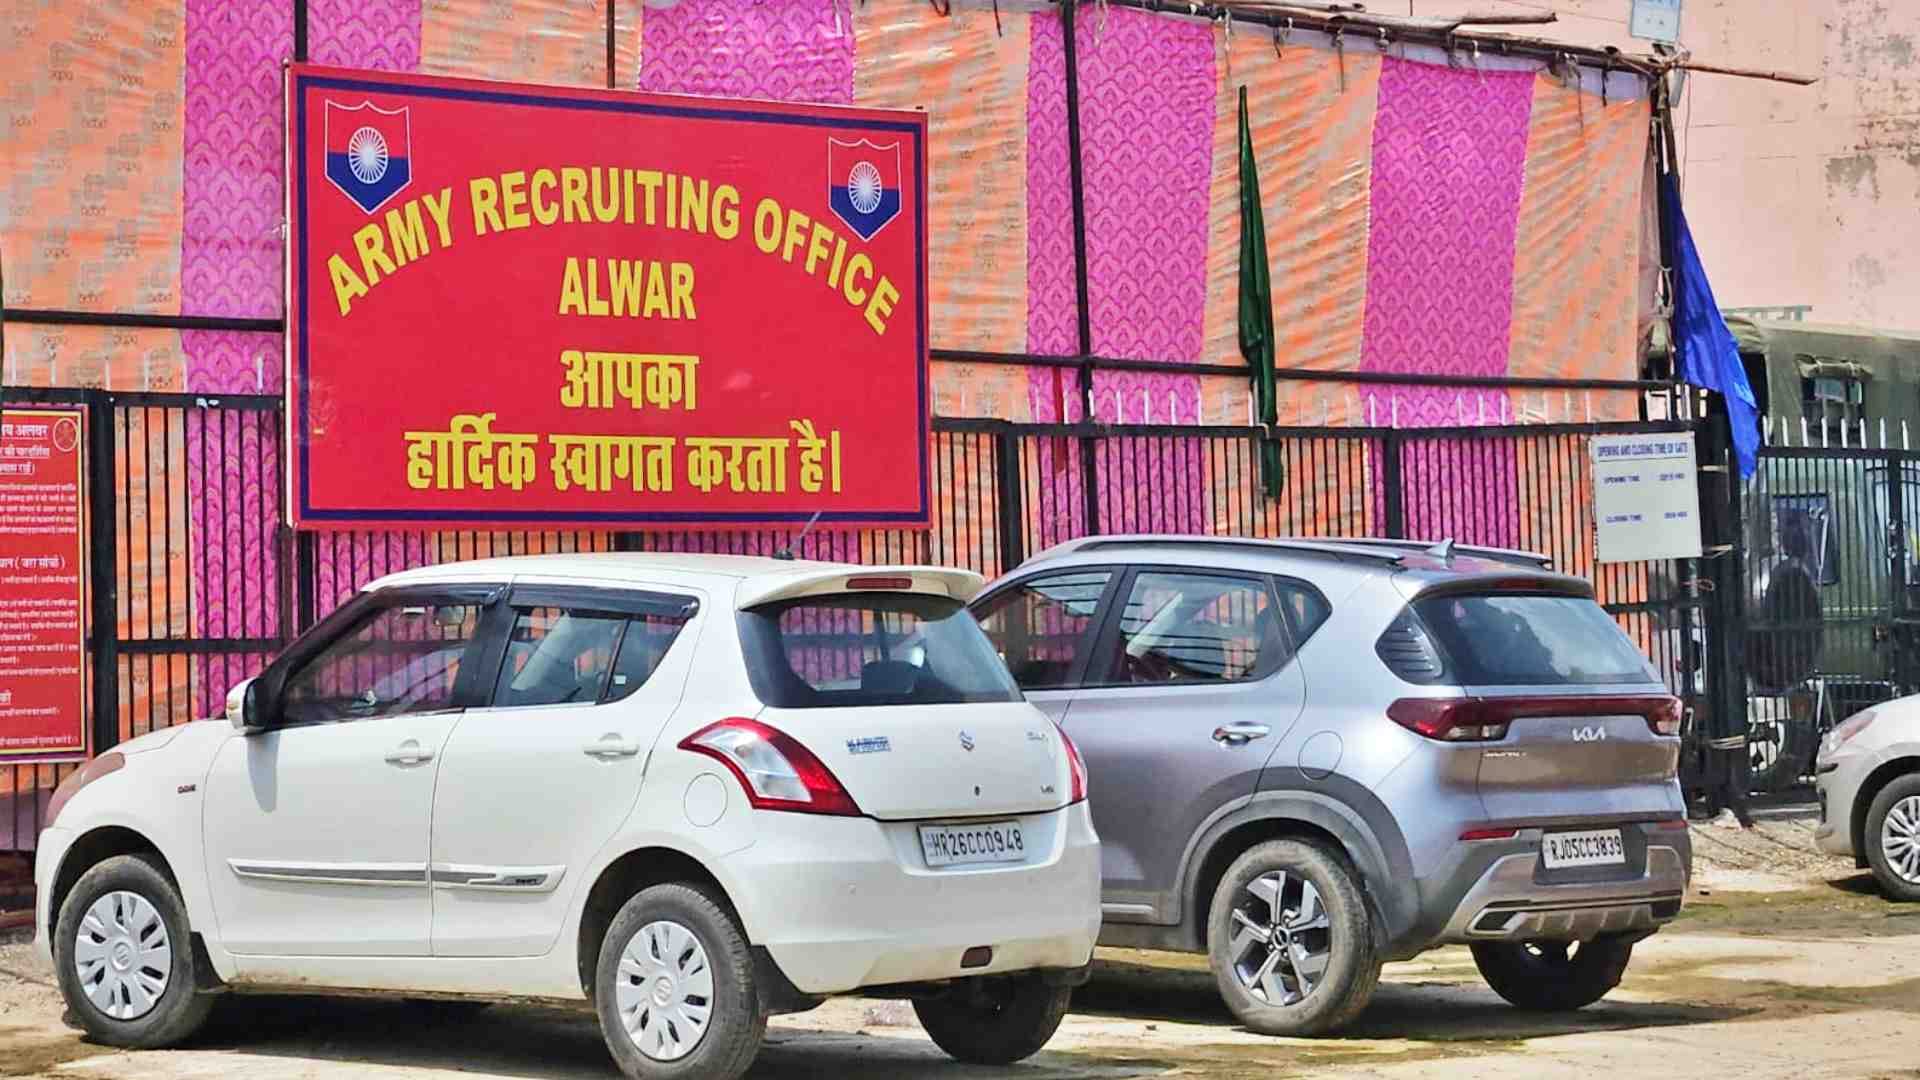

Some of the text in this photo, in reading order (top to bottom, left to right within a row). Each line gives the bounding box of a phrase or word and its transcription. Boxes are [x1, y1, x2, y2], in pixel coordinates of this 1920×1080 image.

[327, 167, 901, 335] ARMY RECRUITING OFFICE
[559, 257, 697, 320] ALWAR
[560, 350, 700, 410] आपका
[404, 412, 539, 491] हार्दिक
[548, 434, 676, 492] स्वागत
[684, 437, 790, 493] करता
[1572, 726, 1606, 741] KIA
[932, 828, 1024, 857] HR26CC0948
